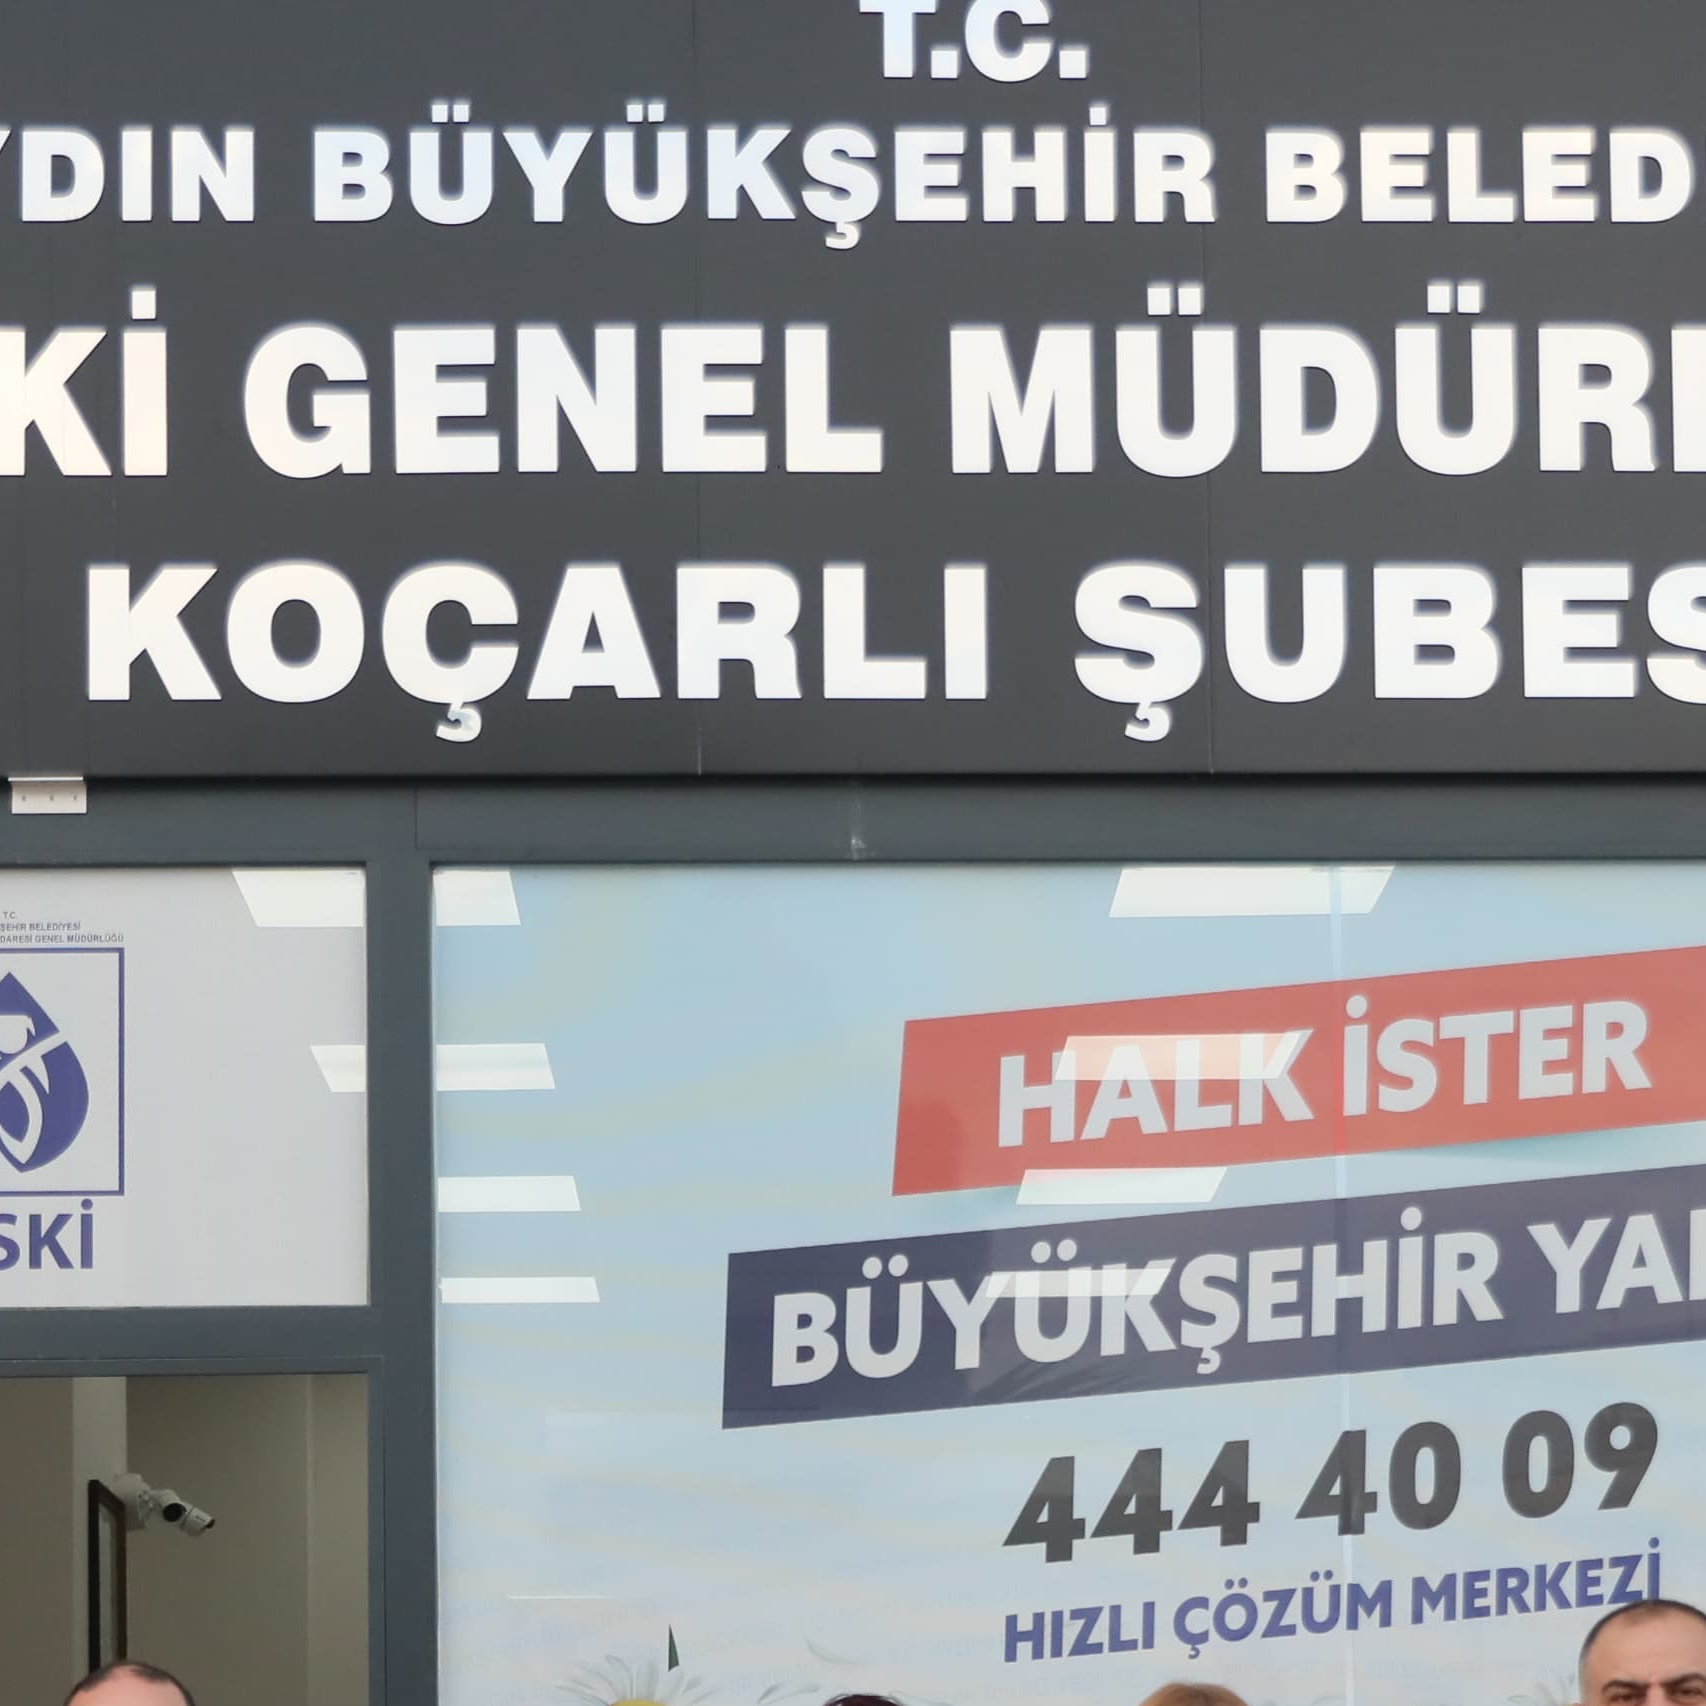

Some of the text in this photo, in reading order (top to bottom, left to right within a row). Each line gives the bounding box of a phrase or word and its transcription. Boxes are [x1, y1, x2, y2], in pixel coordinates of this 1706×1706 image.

[859, 0, 1088, 84] T.C.
[313, 102, 1215, 249] BÜYÜKŞEHİR
[244, 323, 883, 479] GENEL
[88, 560, 987, 742] KOÇARLI
[35, 934, 66, 944] GENEL
[998, 995, 1653, 1149] HALK İSTER
[771, 1206, 1504, 1389] BÜYÜKŞEHİR
[1002, 1402, 1659, 1564] 444 40 09
[1003, 1537, 1661, 1663] HIZLI ÇÖZÜM MERKEZİ
